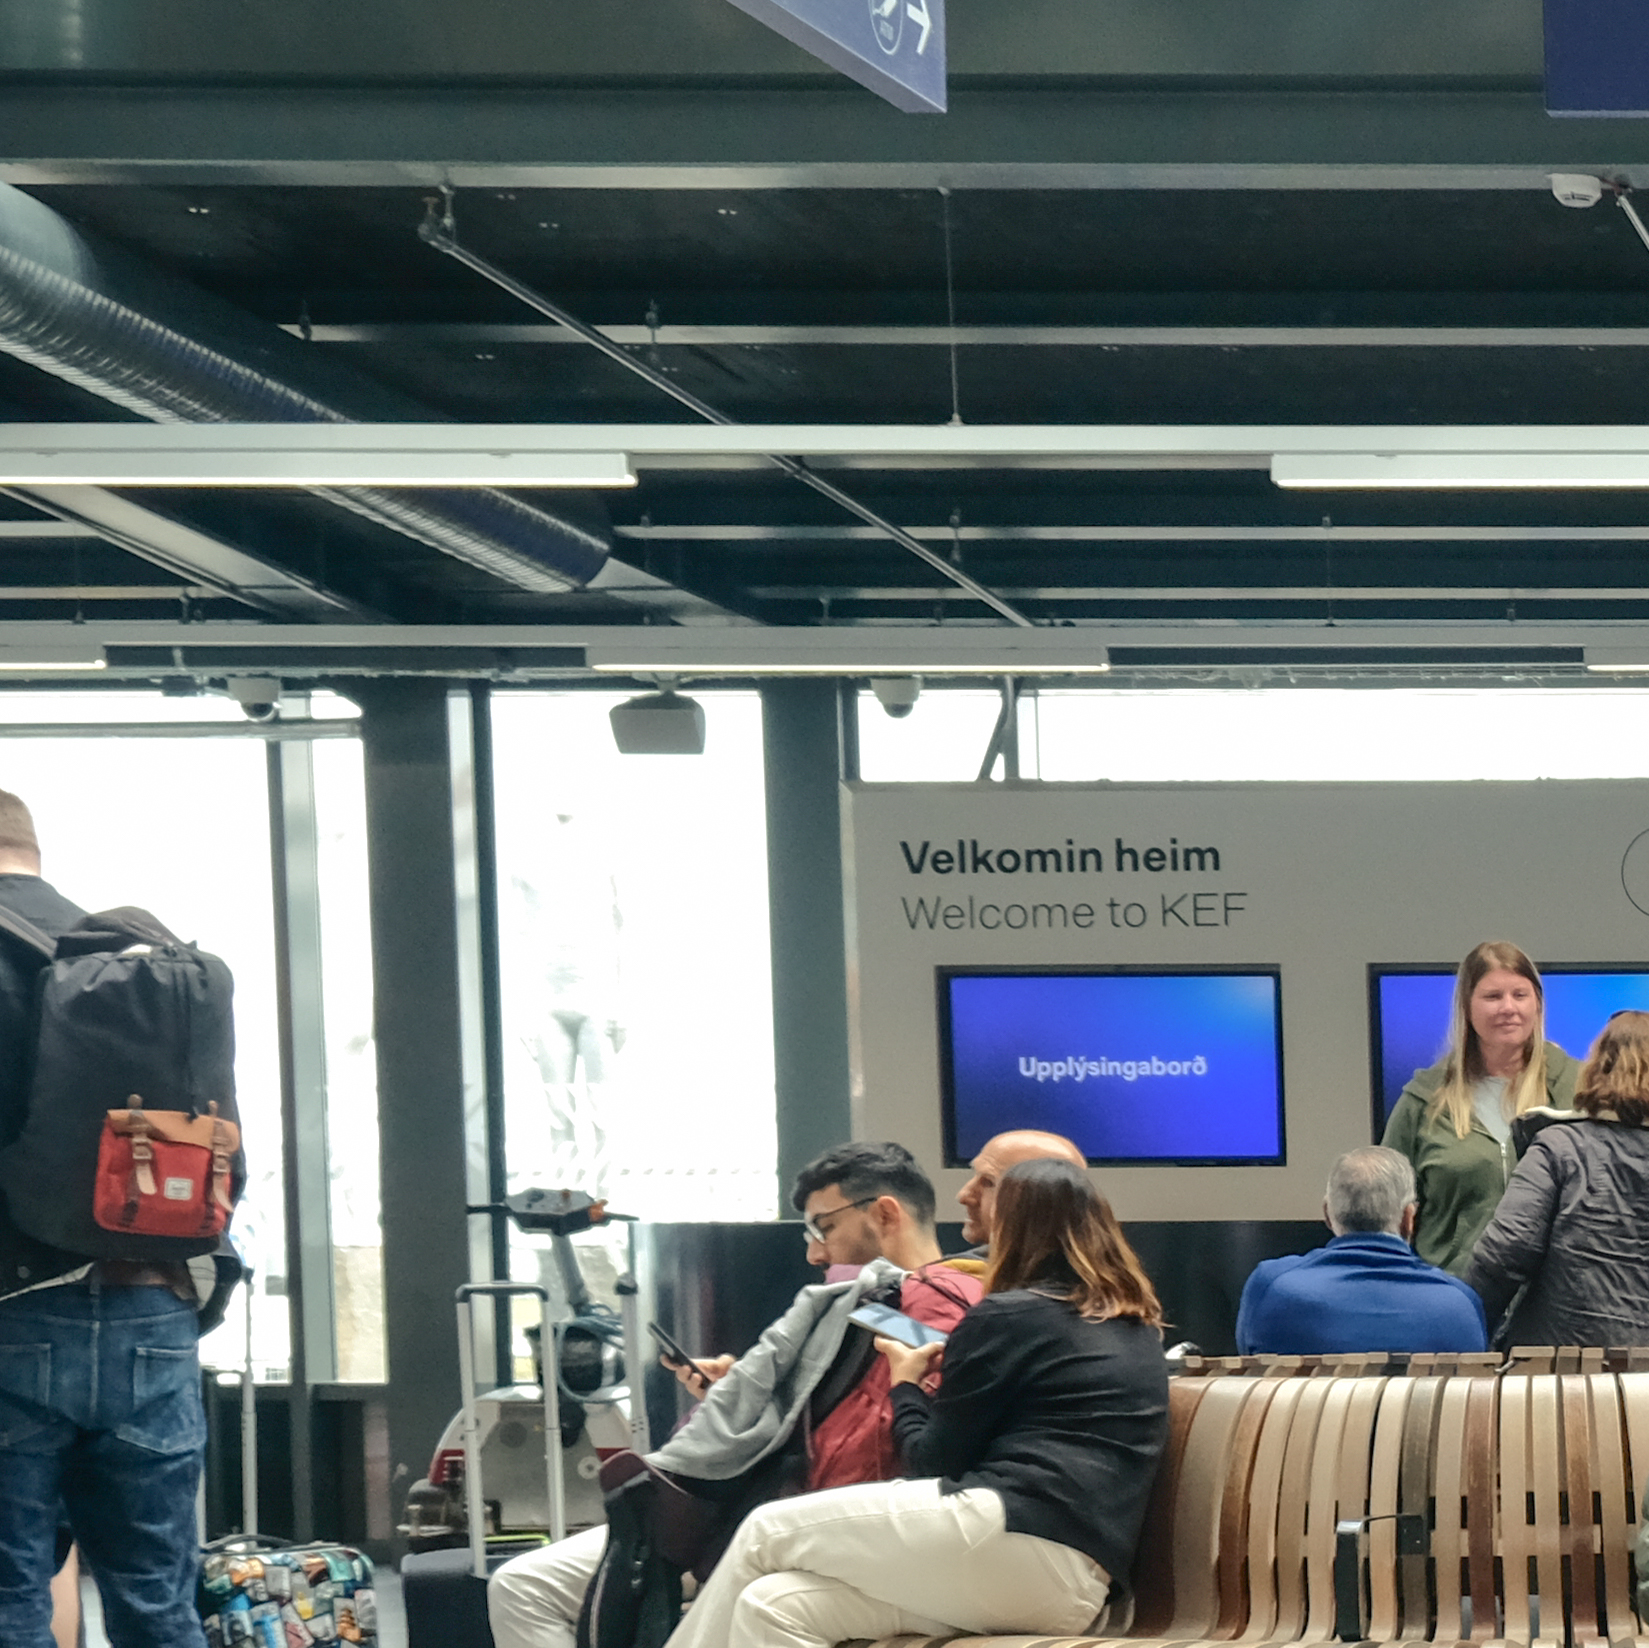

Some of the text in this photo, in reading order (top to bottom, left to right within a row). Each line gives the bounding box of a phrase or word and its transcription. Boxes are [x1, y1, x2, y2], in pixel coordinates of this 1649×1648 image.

[899, 837, 1222, 875] Velkomin heim
[900, 891, 1249, 931] Welcome to KEF
[1018, 1055, 1209, 1083] Upplýsingaborð
